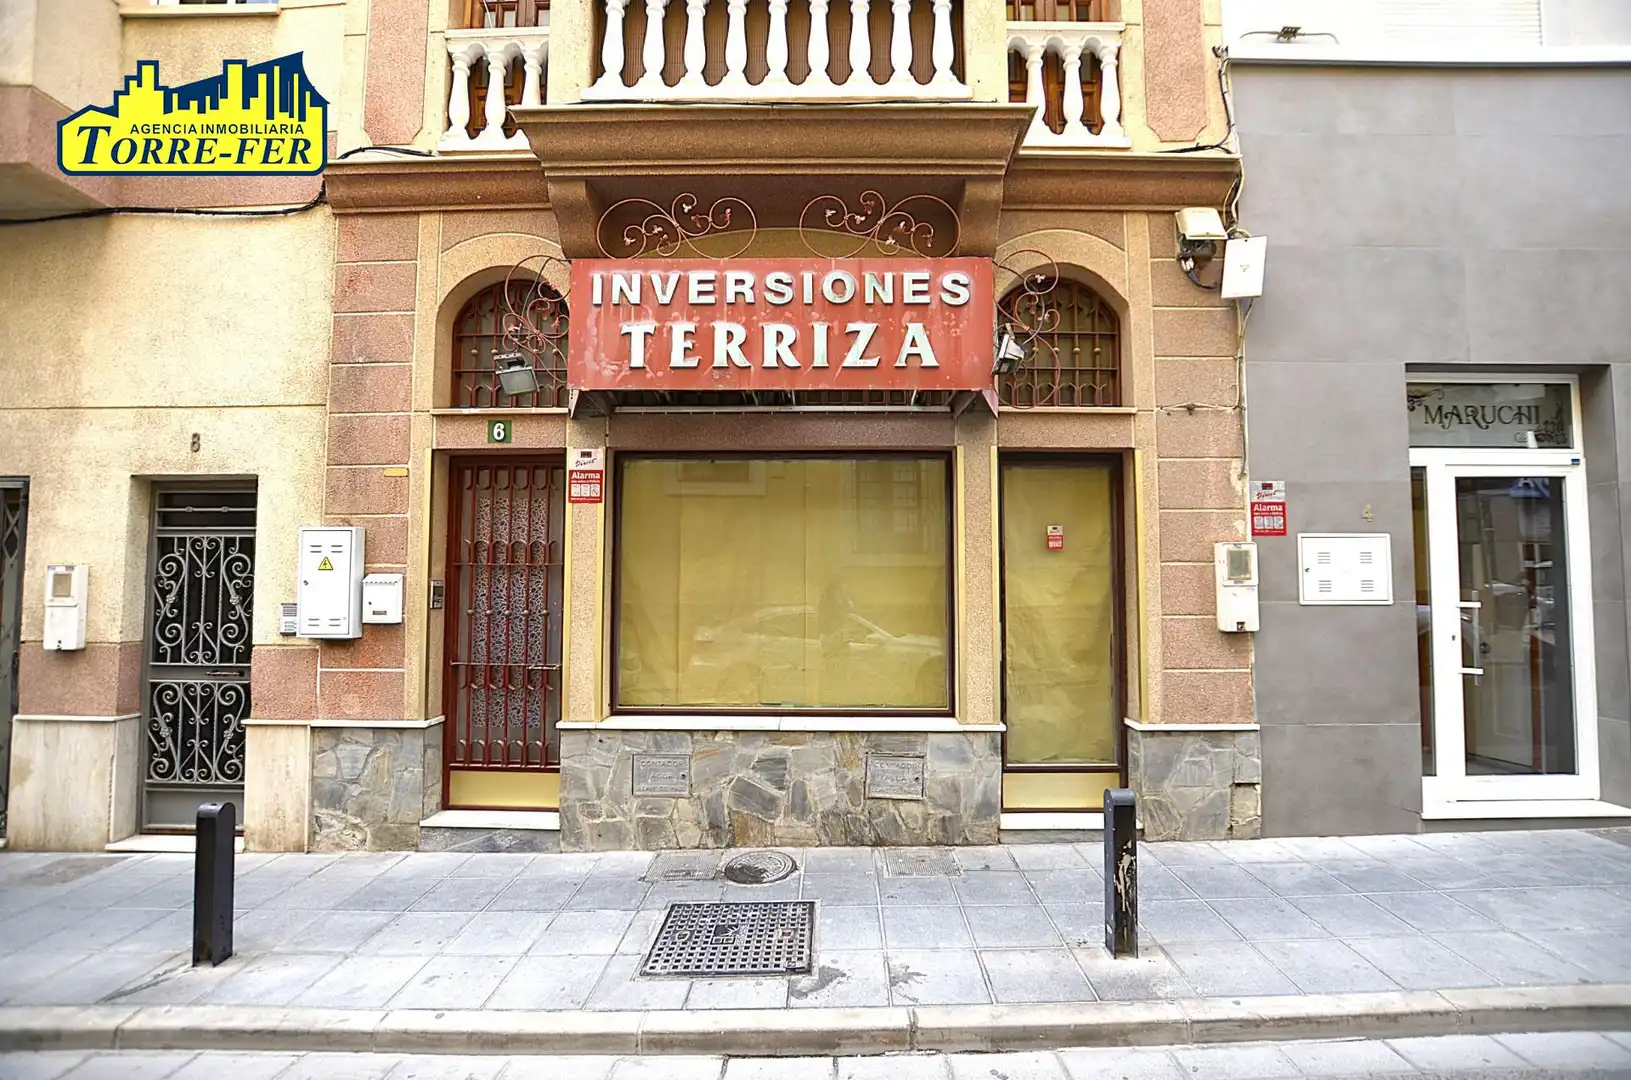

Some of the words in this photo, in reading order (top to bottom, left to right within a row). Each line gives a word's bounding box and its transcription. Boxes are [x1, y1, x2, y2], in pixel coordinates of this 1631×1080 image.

[591, 271, 971, 306] INVERSIONES
[620, 321, 940, 369] TERRIZA
[1423, 403, 1541, 431] MARUCHI
[493, 422, 505, 440] 6
[190, 432, 201, 453] 8
[571, 471, 601, 479] Alarma
[1253, 503, 1283, 512] Alarma
[1361, 503, 1373, 523] 4
